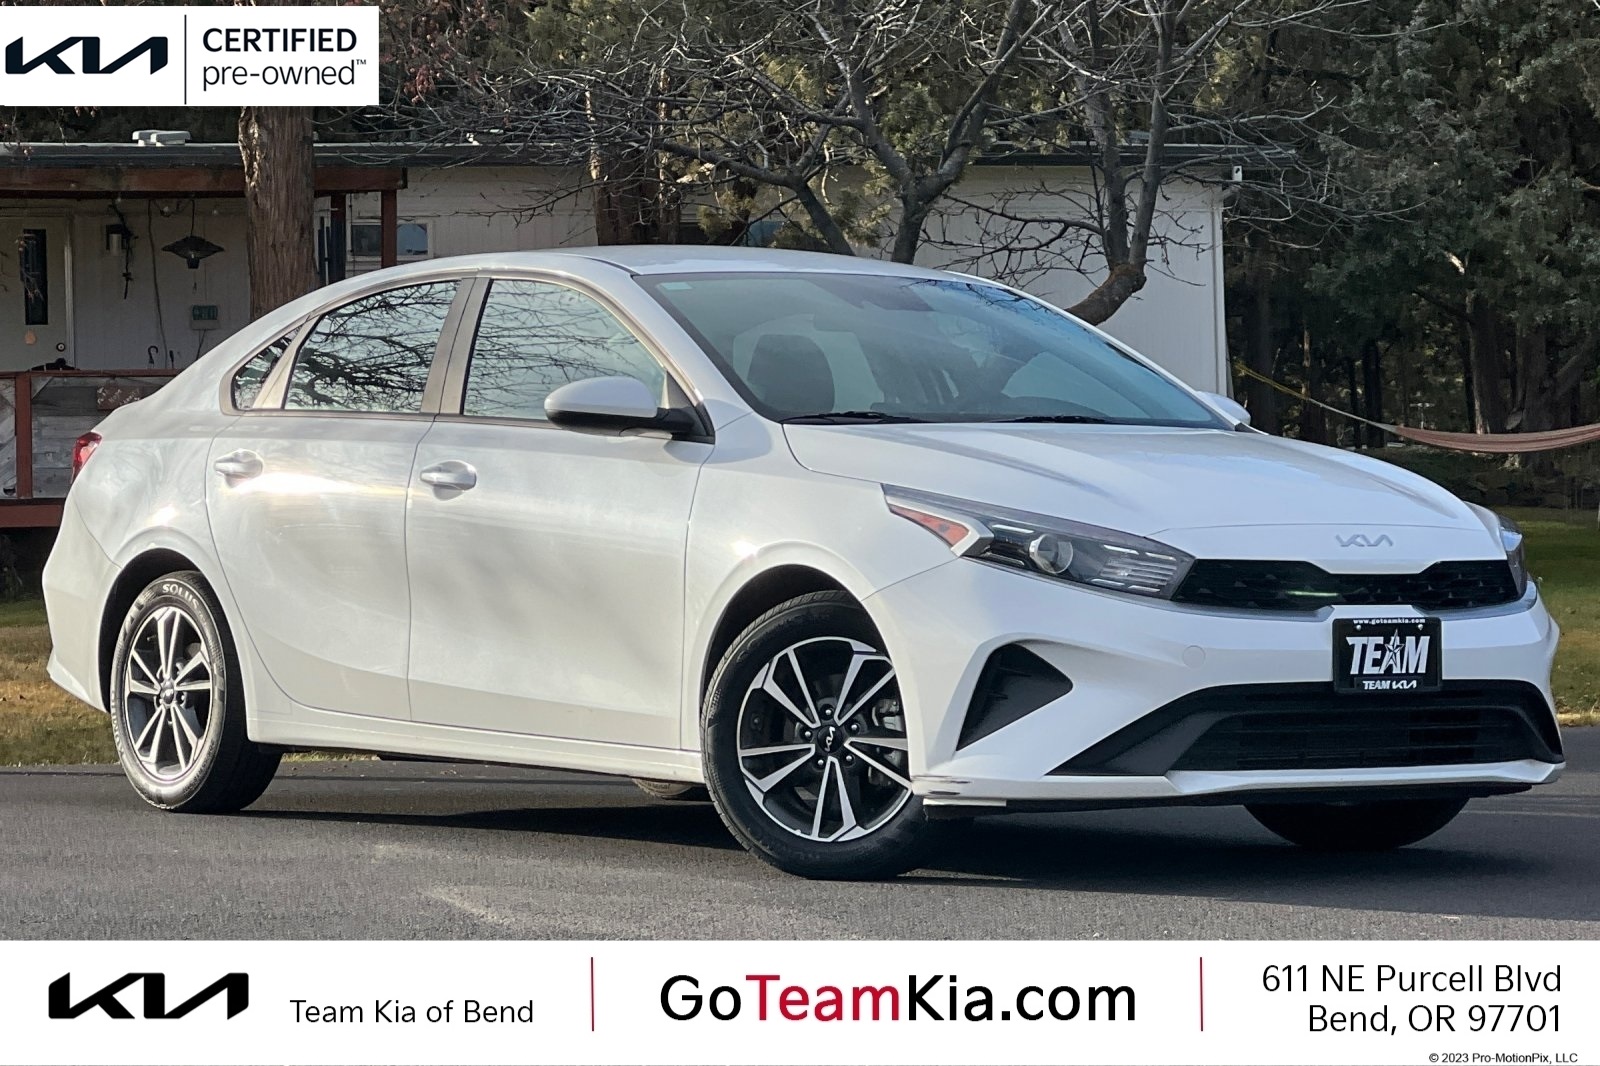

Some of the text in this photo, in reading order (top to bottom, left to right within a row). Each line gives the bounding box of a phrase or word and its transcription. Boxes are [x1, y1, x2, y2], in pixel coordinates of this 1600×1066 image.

[1335, 534, 1394, 548] KIA
[162, 583, 199, 610] SOLUS
[1345, 635, 1430, 675] TEAM
[1362, 680, 1417, 690] TEAM KIA
